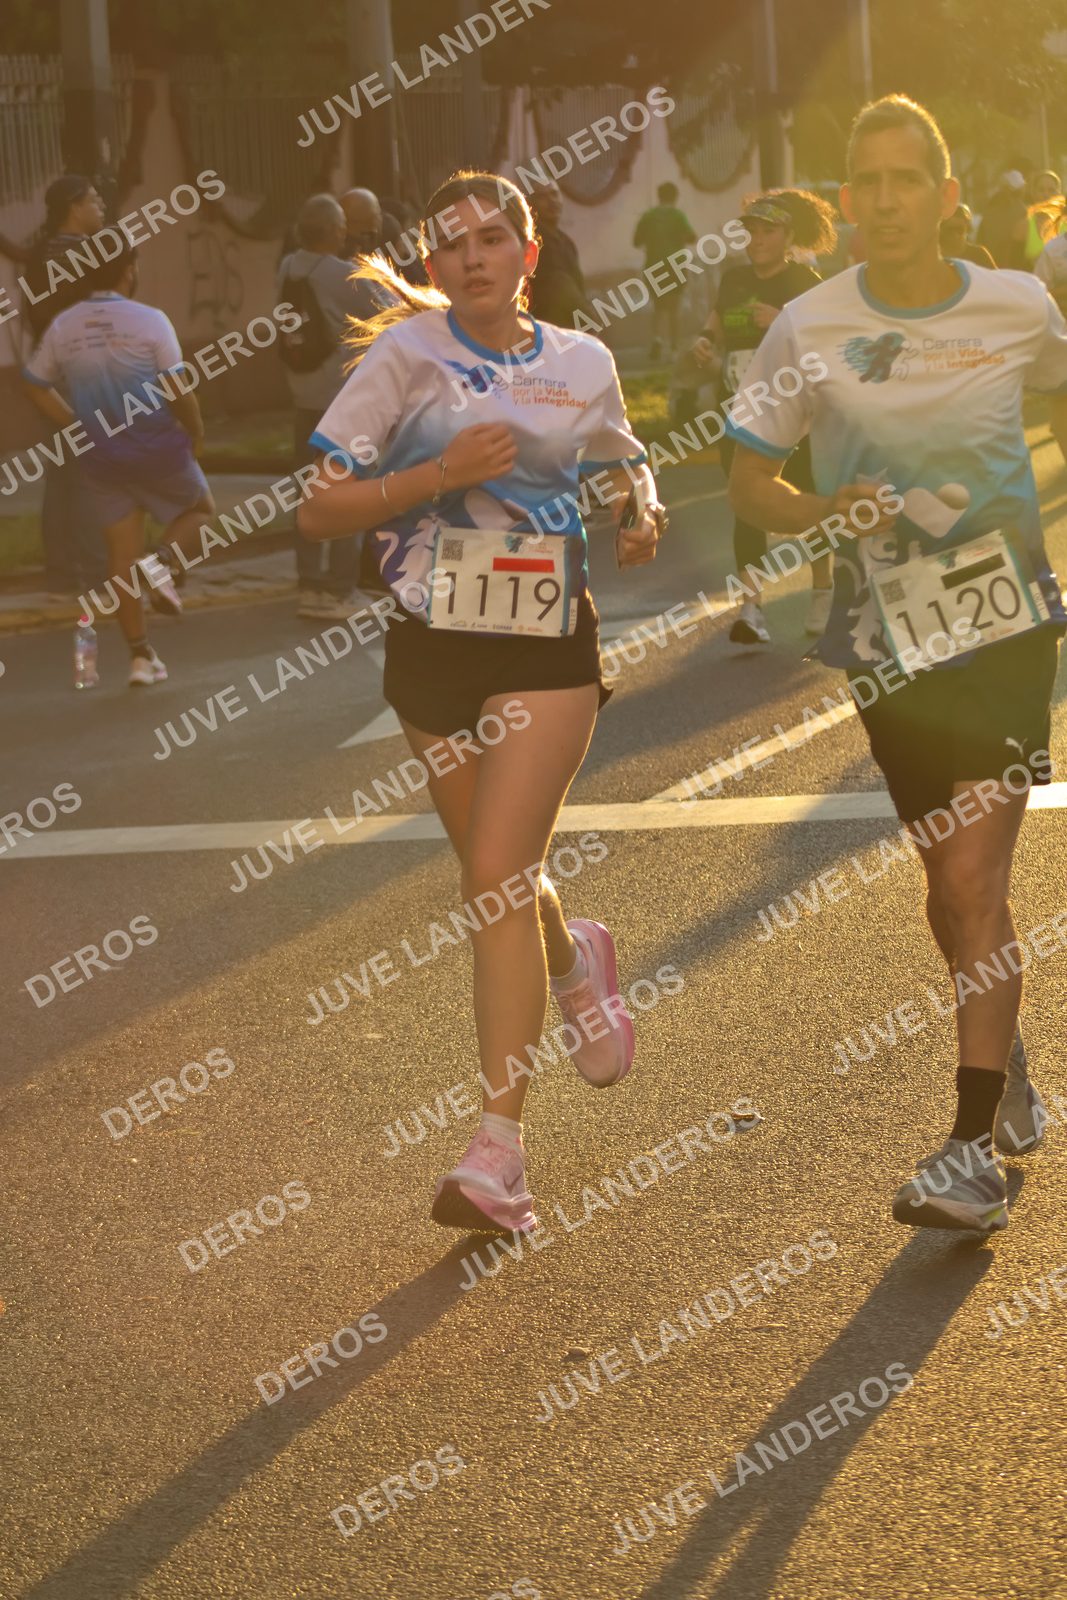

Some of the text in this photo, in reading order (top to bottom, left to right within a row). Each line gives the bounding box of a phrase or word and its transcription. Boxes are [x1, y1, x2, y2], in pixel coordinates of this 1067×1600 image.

[922, 337, 983, 350] Carrera
[959, 348, 985, 358] Vida
[947, 354, 1005, 370] Integridad
[512, 375, 567, 388] Carrera
[512, 387, 569, 397] por la Vida
[521, 396, 532, 405] la
[534, 396, 587, 409] Integridad
[445, 571, 561, 621] 1119
[897, 576, 1020, 652] 1120
